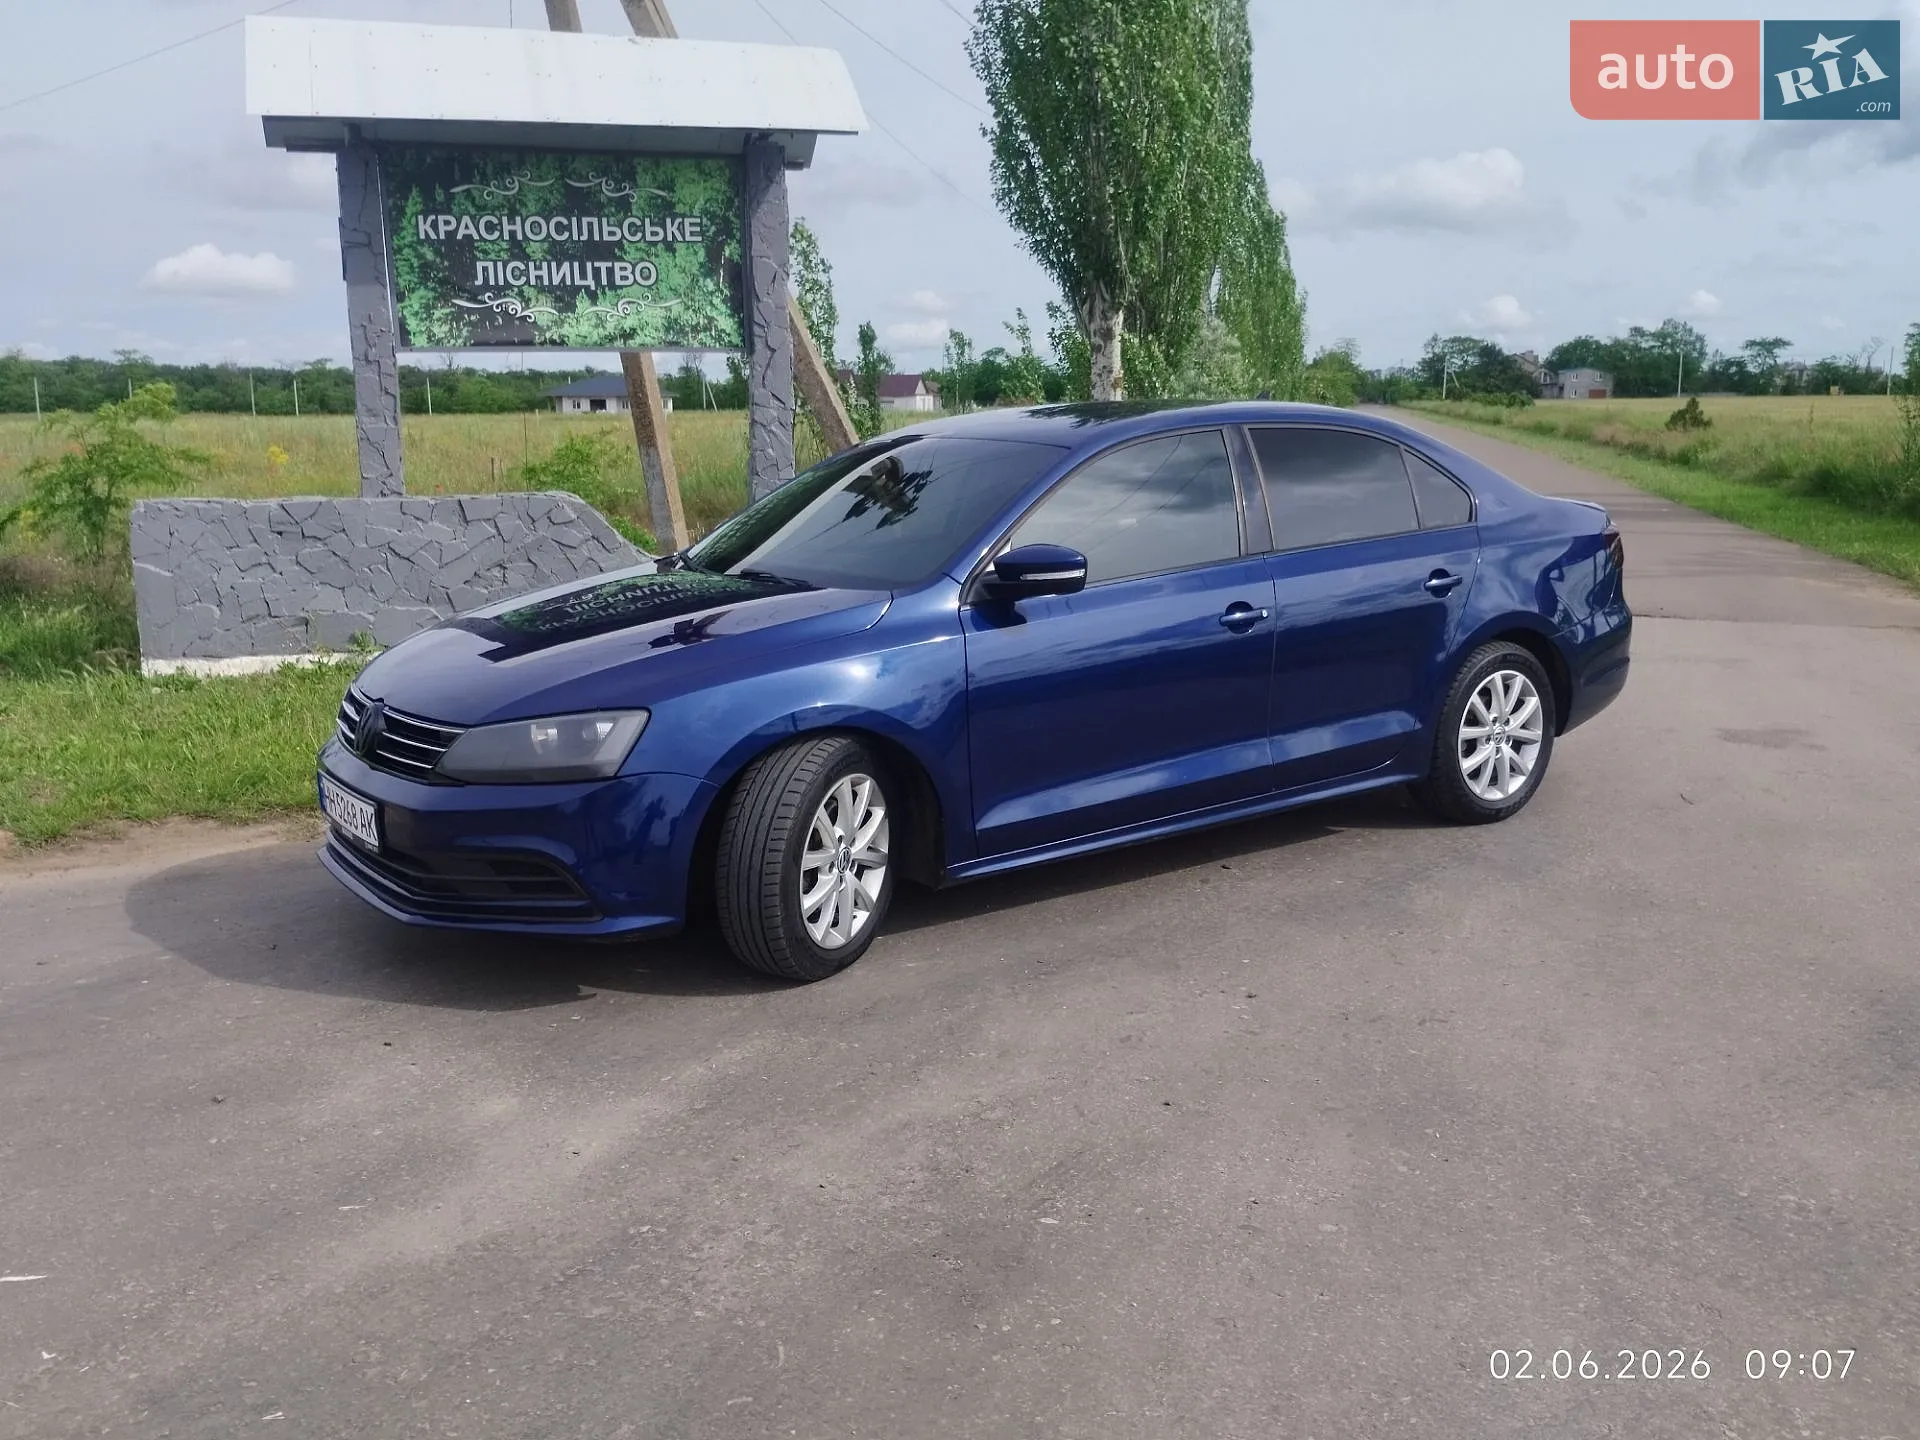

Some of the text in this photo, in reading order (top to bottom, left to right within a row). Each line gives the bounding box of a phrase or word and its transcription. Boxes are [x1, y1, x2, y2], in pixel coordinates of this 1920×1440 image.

[417, 213, 703, 243] КРАСНОСІЛЬСЬКЕ
[474, 260, 658, 291] ЛІСНИЦТВО
[359, 806, 379, 842] AK
